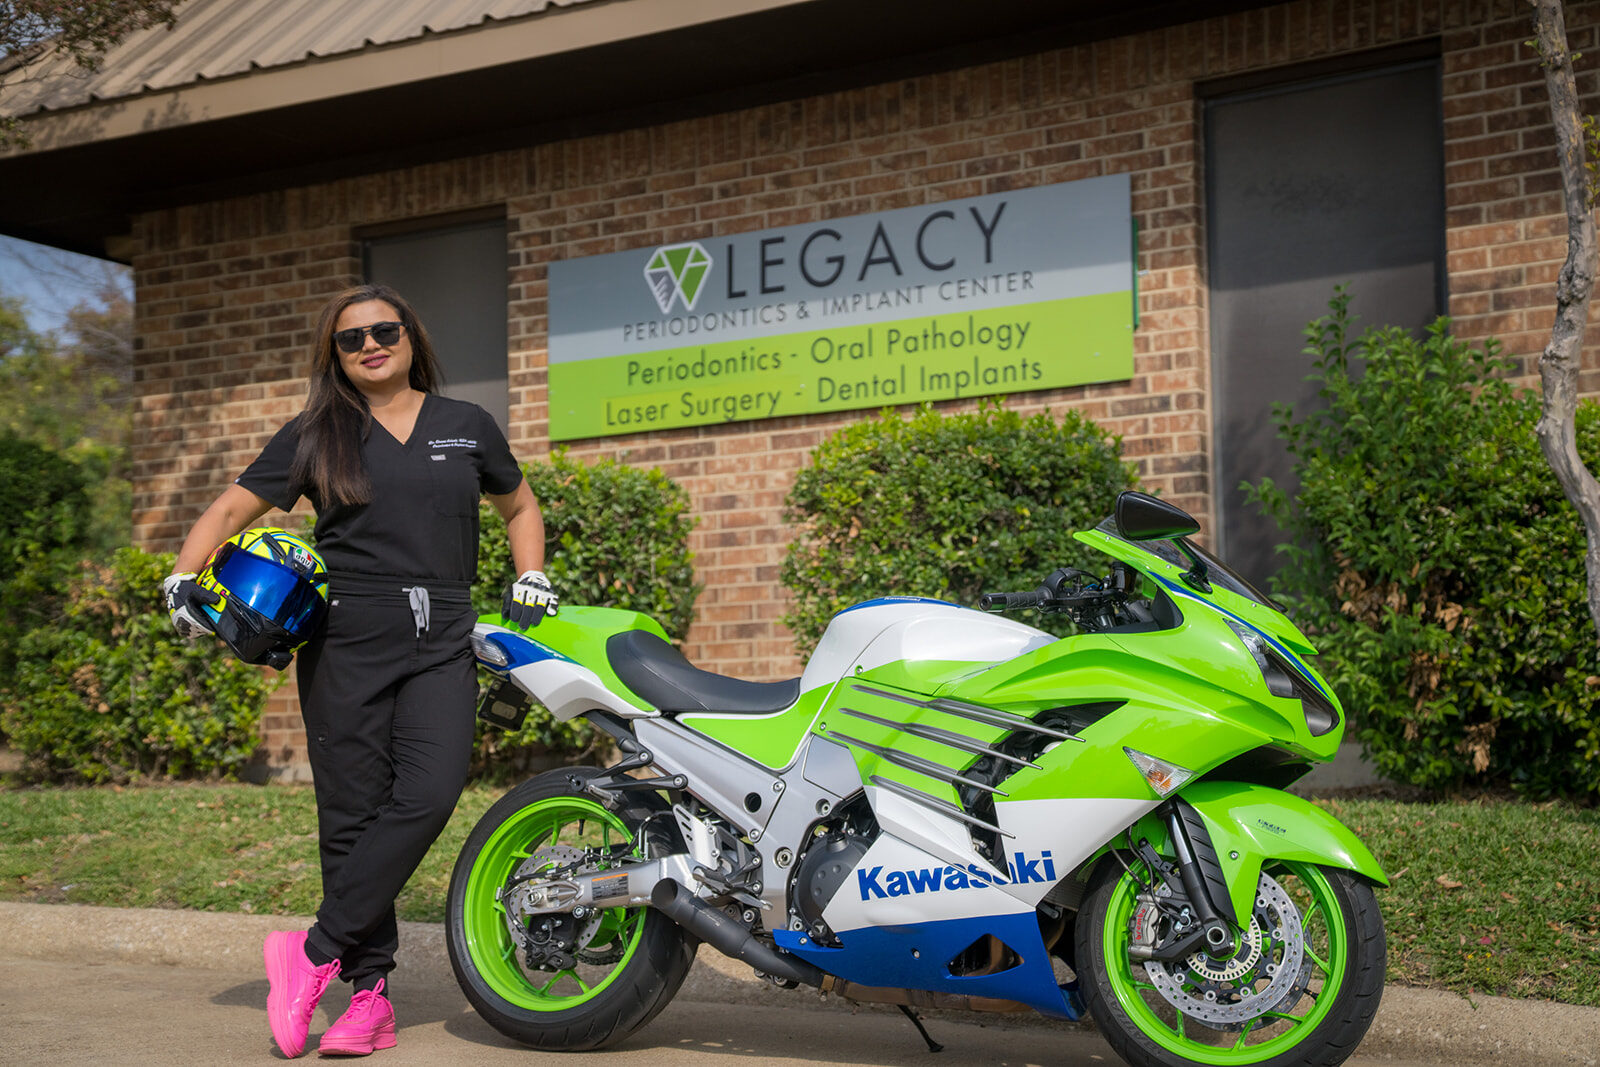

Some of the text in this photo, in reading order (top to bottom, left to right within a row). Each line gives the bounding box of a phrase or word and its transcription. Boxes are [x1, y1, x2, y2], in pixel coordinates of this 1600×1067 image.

[727, 201, 1007, 298] LEGACY
[623, 270, 1034, 342] PERIODONTICS & IMPLANT CENTER
[627, 346, 782, 386] Periodontics
[810, 327, 873, 364] Oral
[887, 315, 1031, 355] Pathology
[606, 401, 669, 426] Laser
[680, 390, 782, 421] Surgery
[818, 363, 906, 403] Dental
[920, 355, 1043, 398] Implants
[1135, 908, 1146, 940] brembo
